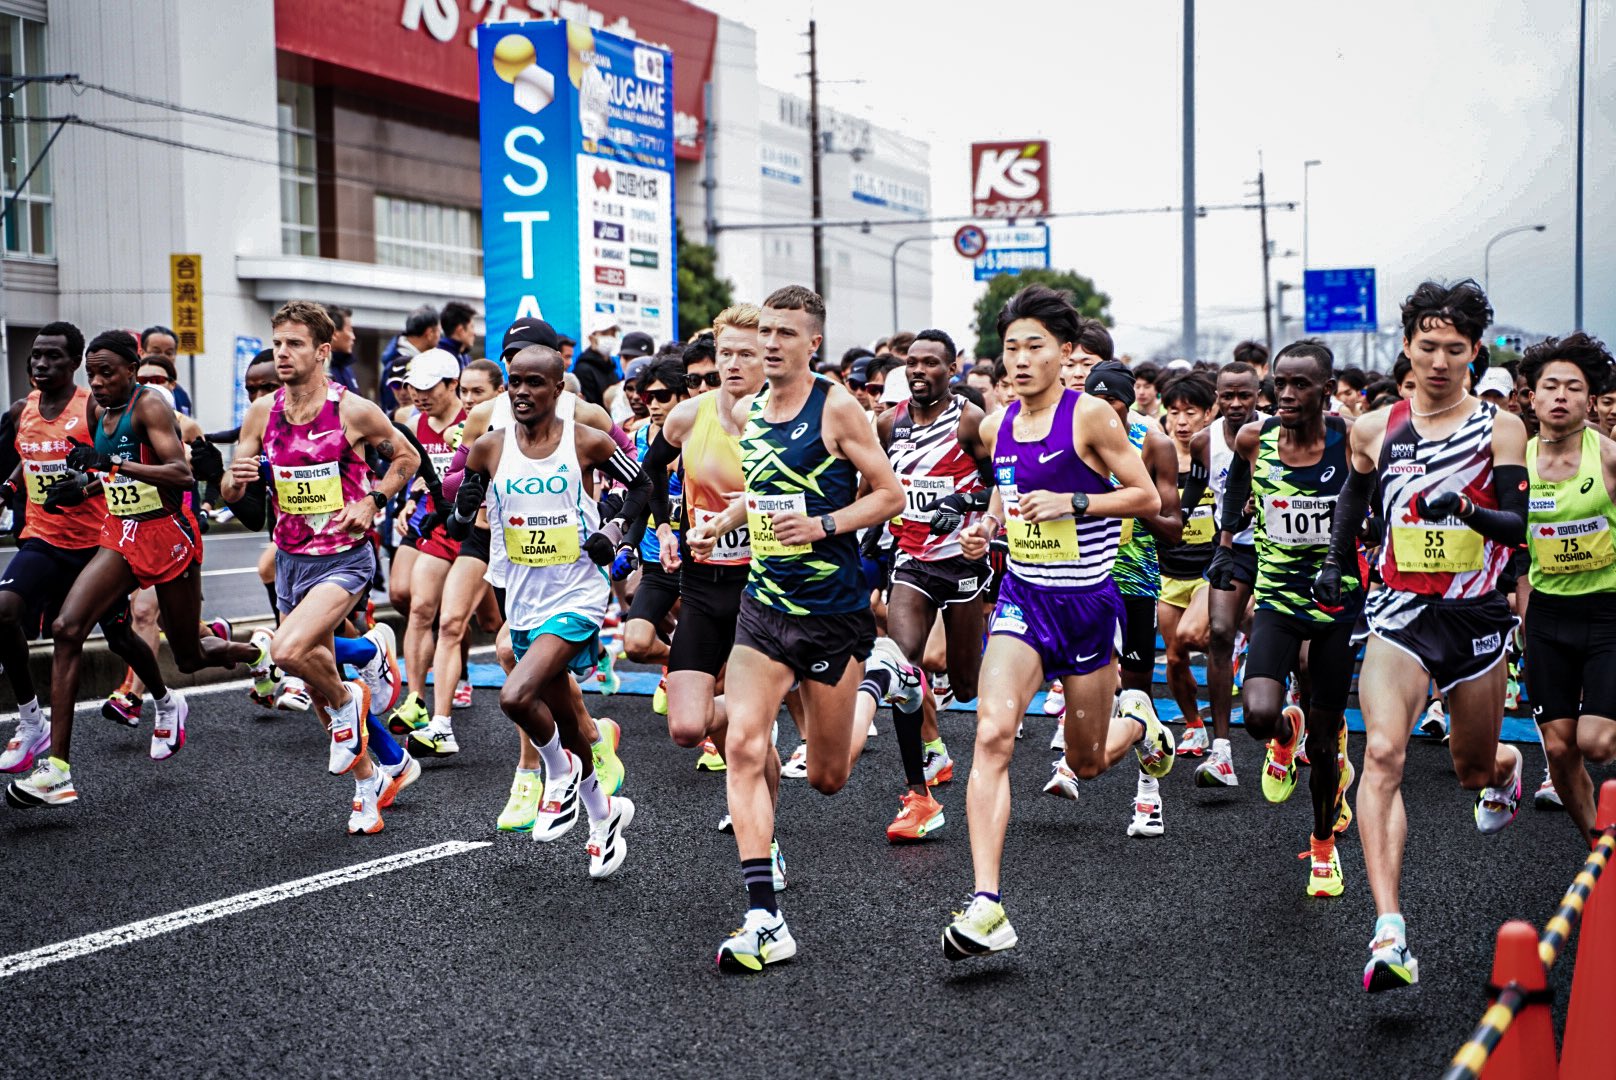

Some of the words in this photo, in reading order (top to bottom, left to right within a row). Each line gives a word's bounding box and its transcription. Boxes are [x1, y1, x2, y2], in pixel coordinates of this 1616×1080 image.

[177, 256, 199, 352] 合流注意
[20, 440, 75, 453] 日本薬科
[42, 464, 69, 472] 四国化
[294, 467, 332, 479] 四国化成
[1390, 465, 1424, 473] TOYOTA
[297, 482, 312, 495] 51
[913, 480, 946, 489] 四国化成
[109, 485, 141, 506] 323
[287, 494, 327, 504] ROBINSON
[758, 500, 794, 510] 四国化成
[527, 514, 568, 526] 四国化成
[1281, 512, 1332, 534] 101
[1025, 523, 1042, 539] 74
[1557, 520, 1599, 536] 四国化成
[529, 530, 546, 544] 72
[1425, 531, 1444, 547] 55
[521, 545, 557, 555] LEDAMA
[1014, 538, 1061, 550] SHINOHARA
[1560, 538, 1579, 553] 75
[1424, 548, 1446, 558] OTA
[1554, 551, 1593, 563] YOSHIDA
[1475, 635, 1499, 648] MOVE
